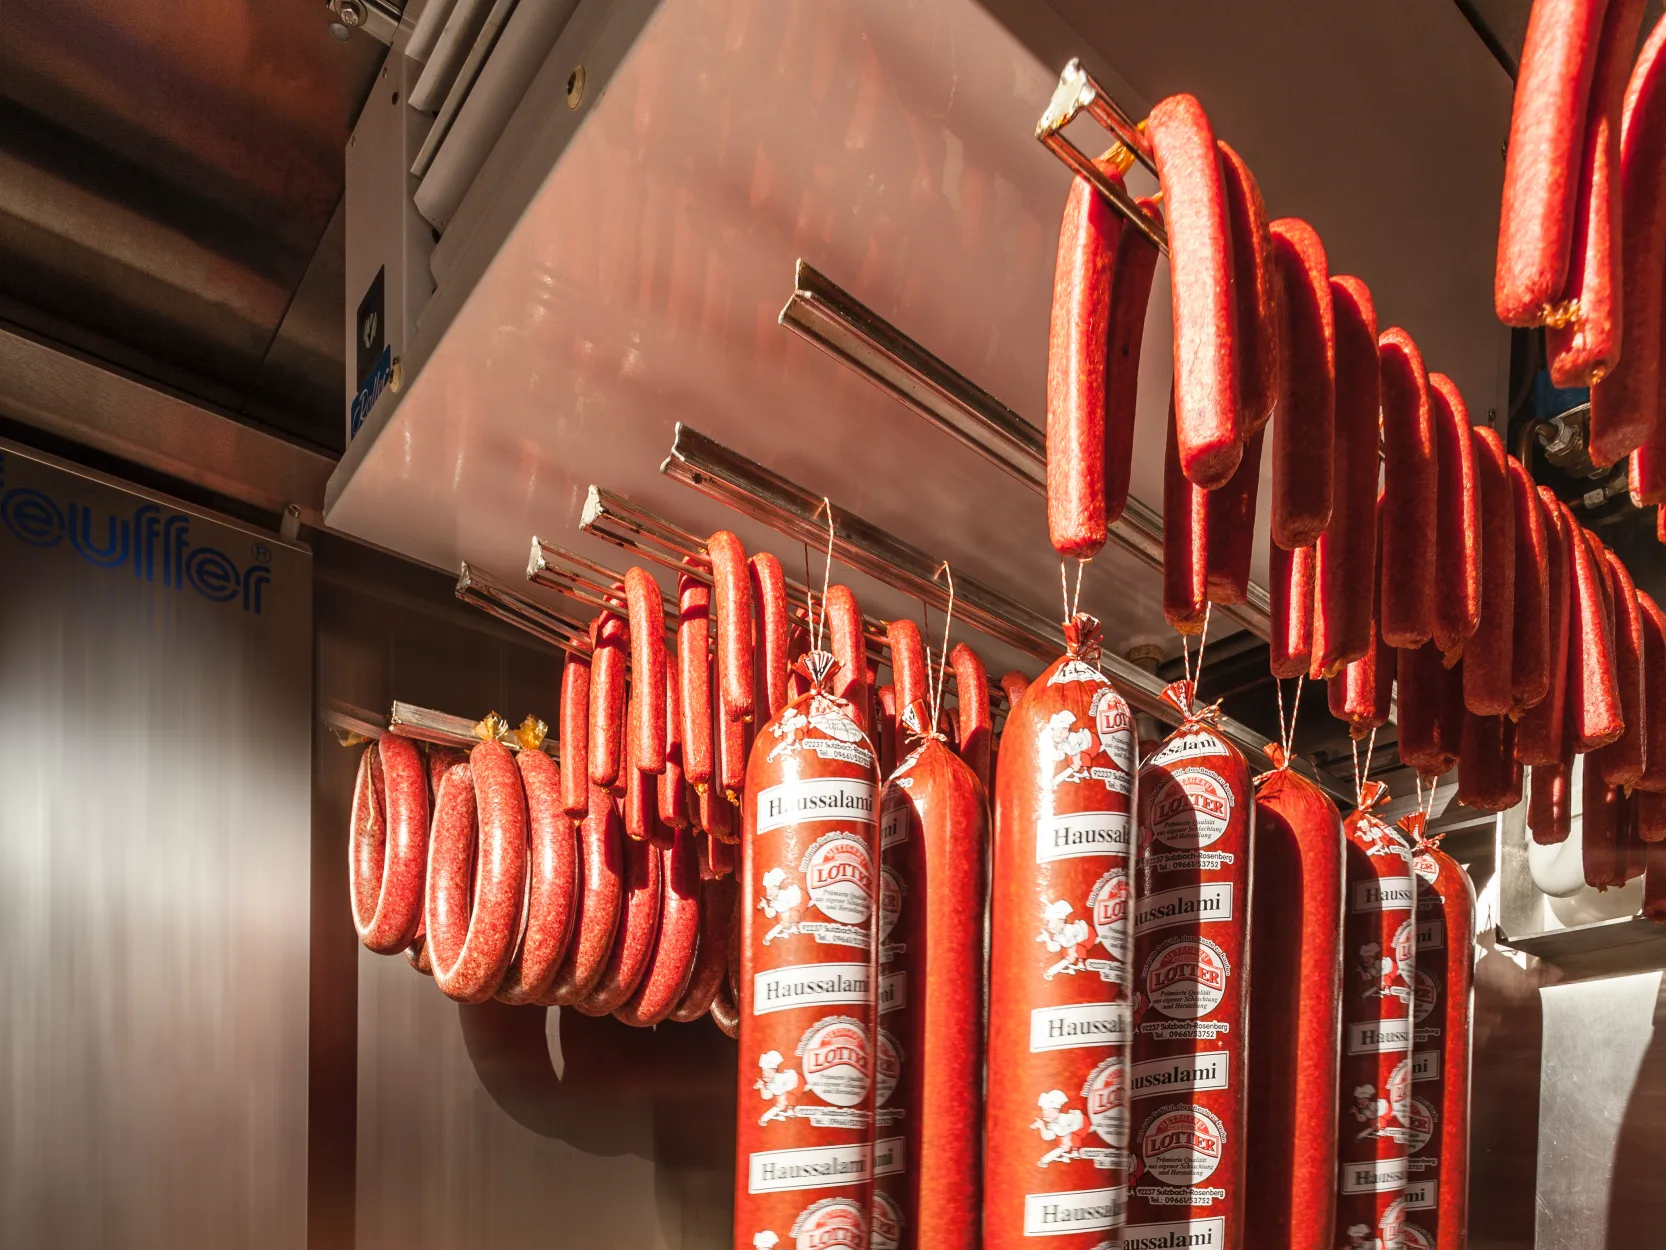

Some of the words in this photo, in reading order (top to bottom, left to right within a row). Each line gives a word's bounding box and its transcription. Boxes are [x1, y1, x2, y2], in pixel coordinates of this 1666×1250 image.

[1158, 794, 1224, 818] LOTTER
[1165, 851, 1233, 863] Sulzbach-Rosenberg
[1173, 861, 1219, 869] 09661/53752
[1135, 893, 1221, 926] ussalami
[1154, 963, 1220, 986] LOTTER
[1142, 1023, 1160, 1032] 92237
[1161, 1021, 1228, 1032] Sulzbach-Rosenberg
[1169, 1031, 1215, 1039] 09661/53752
[1131, 1062, 1217, 1091] ussalami
[1149, 1131, 1215, 1152] LOTTER
[1156, 1187, 1224, 1197] Sulzbach-Rosenberg
